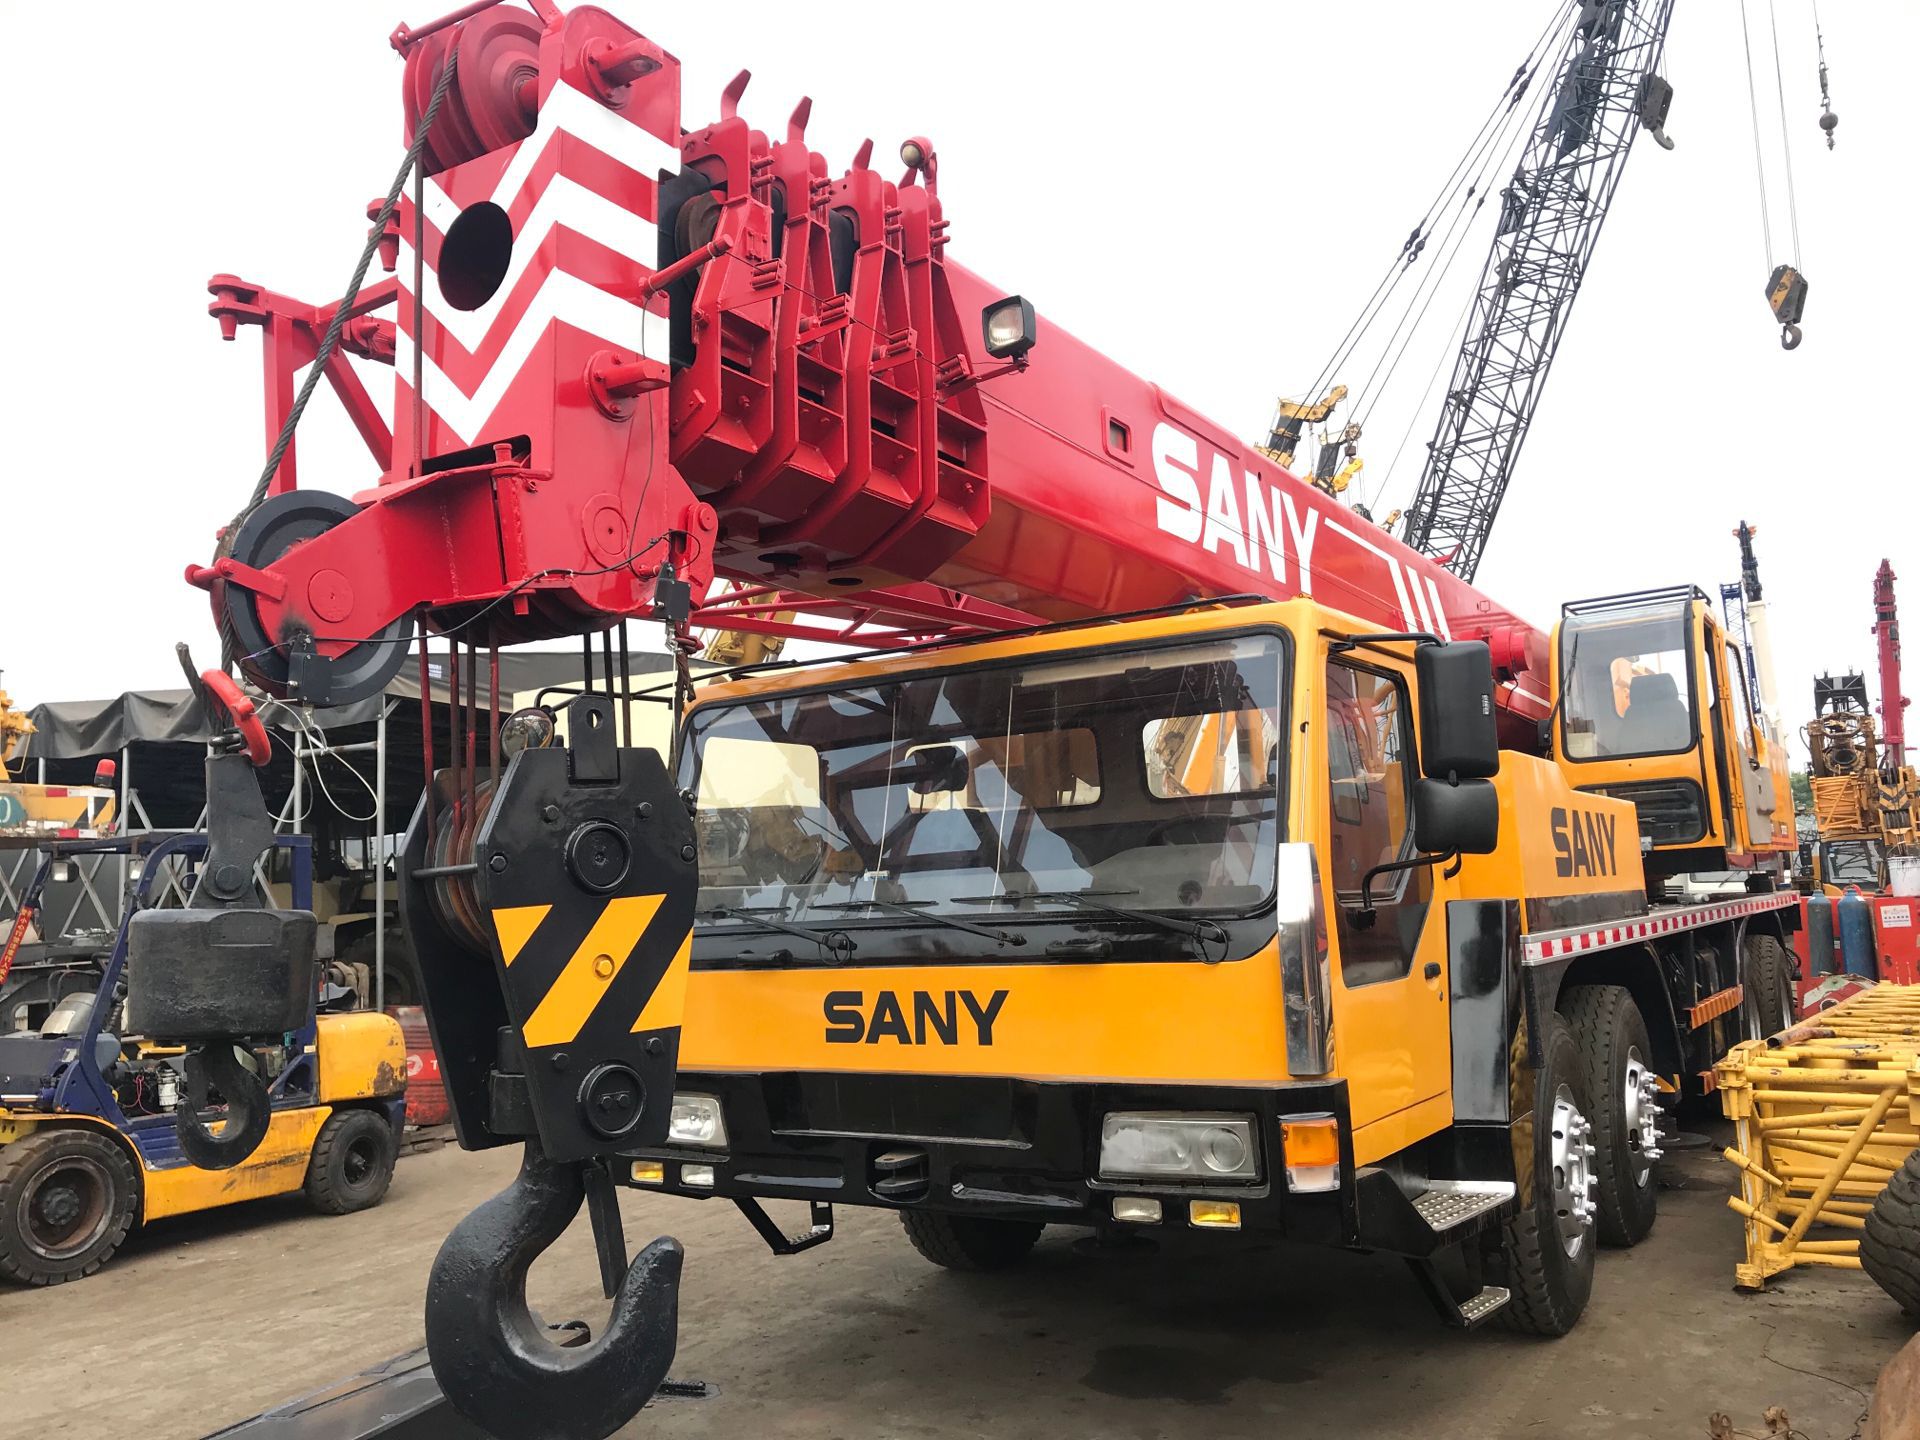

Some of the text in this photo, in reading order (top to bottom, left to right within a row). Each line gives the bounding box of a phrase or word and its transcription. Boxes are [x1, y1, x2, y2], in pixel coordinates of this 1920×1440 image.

[1152, 422, 1319, 596] SANY
[1551, 806, 1617, 877] SANY
[824, 990, 1009, 1046] SANY
